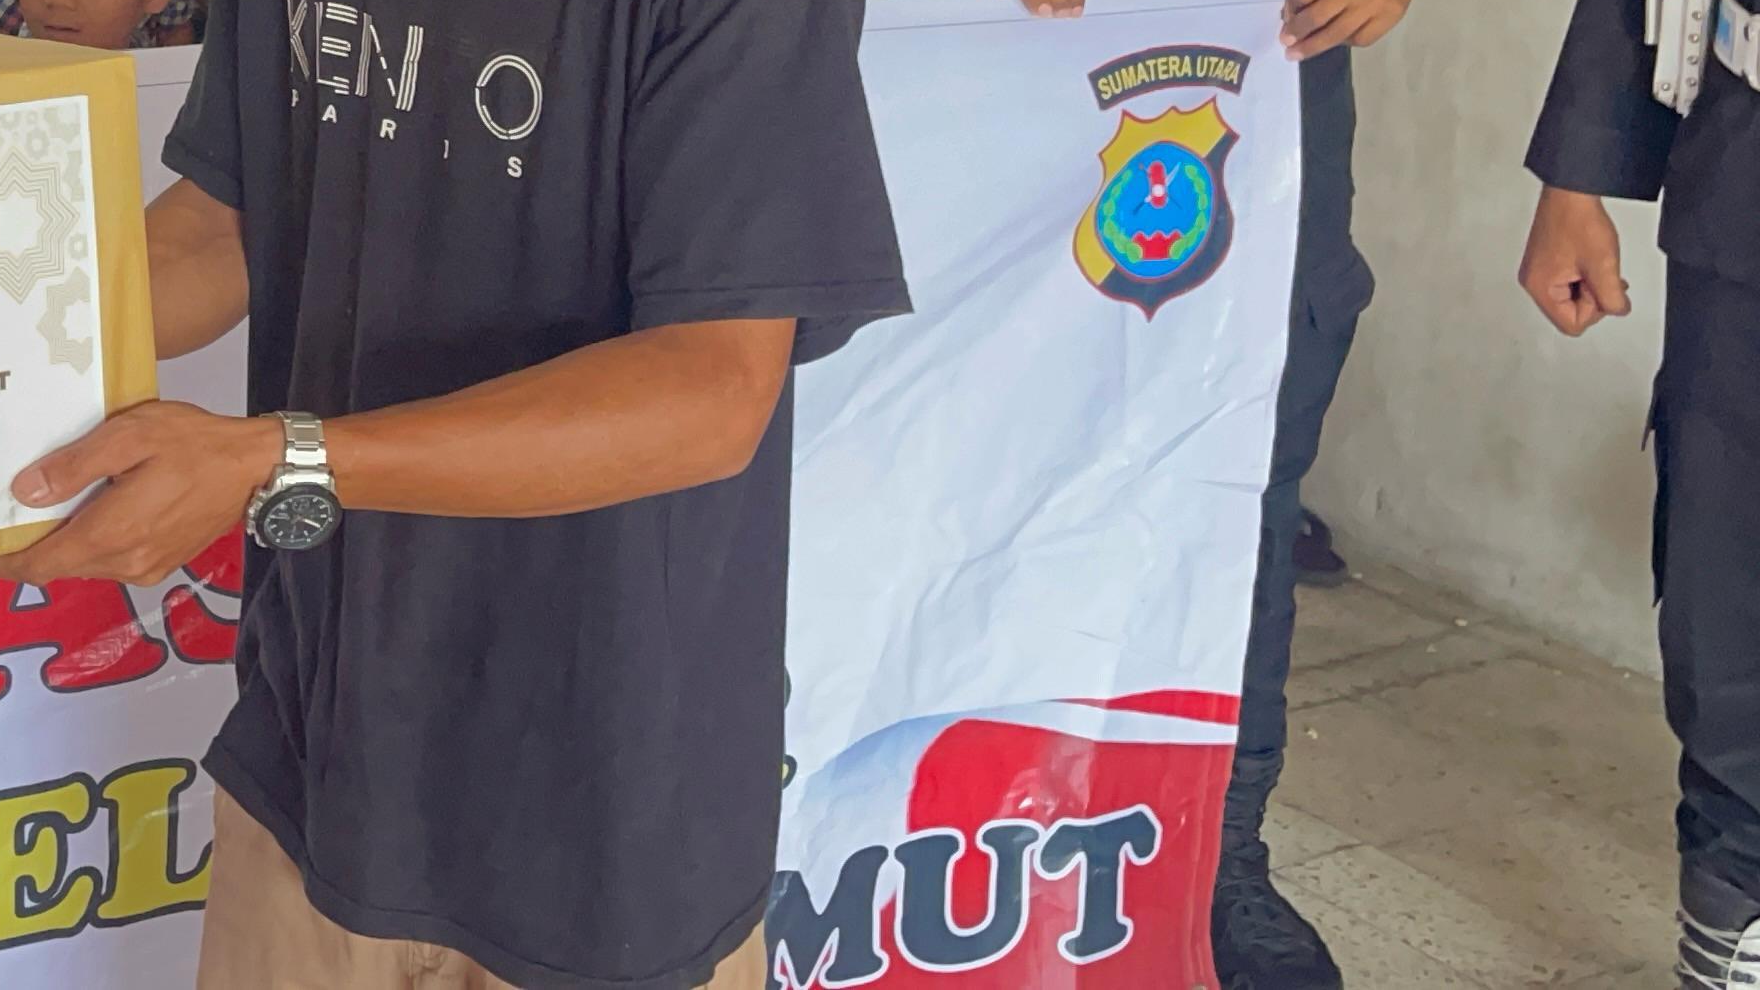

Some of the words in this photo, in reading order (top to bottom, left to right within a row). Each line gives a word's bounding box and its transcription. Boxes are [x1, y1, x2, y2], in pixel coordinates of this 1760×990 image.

[1097, 55, 1192, 100] SUMATERA
[1195, 56, 1241, 85] UTARA
[765, 805, 1162, 990] MUT
